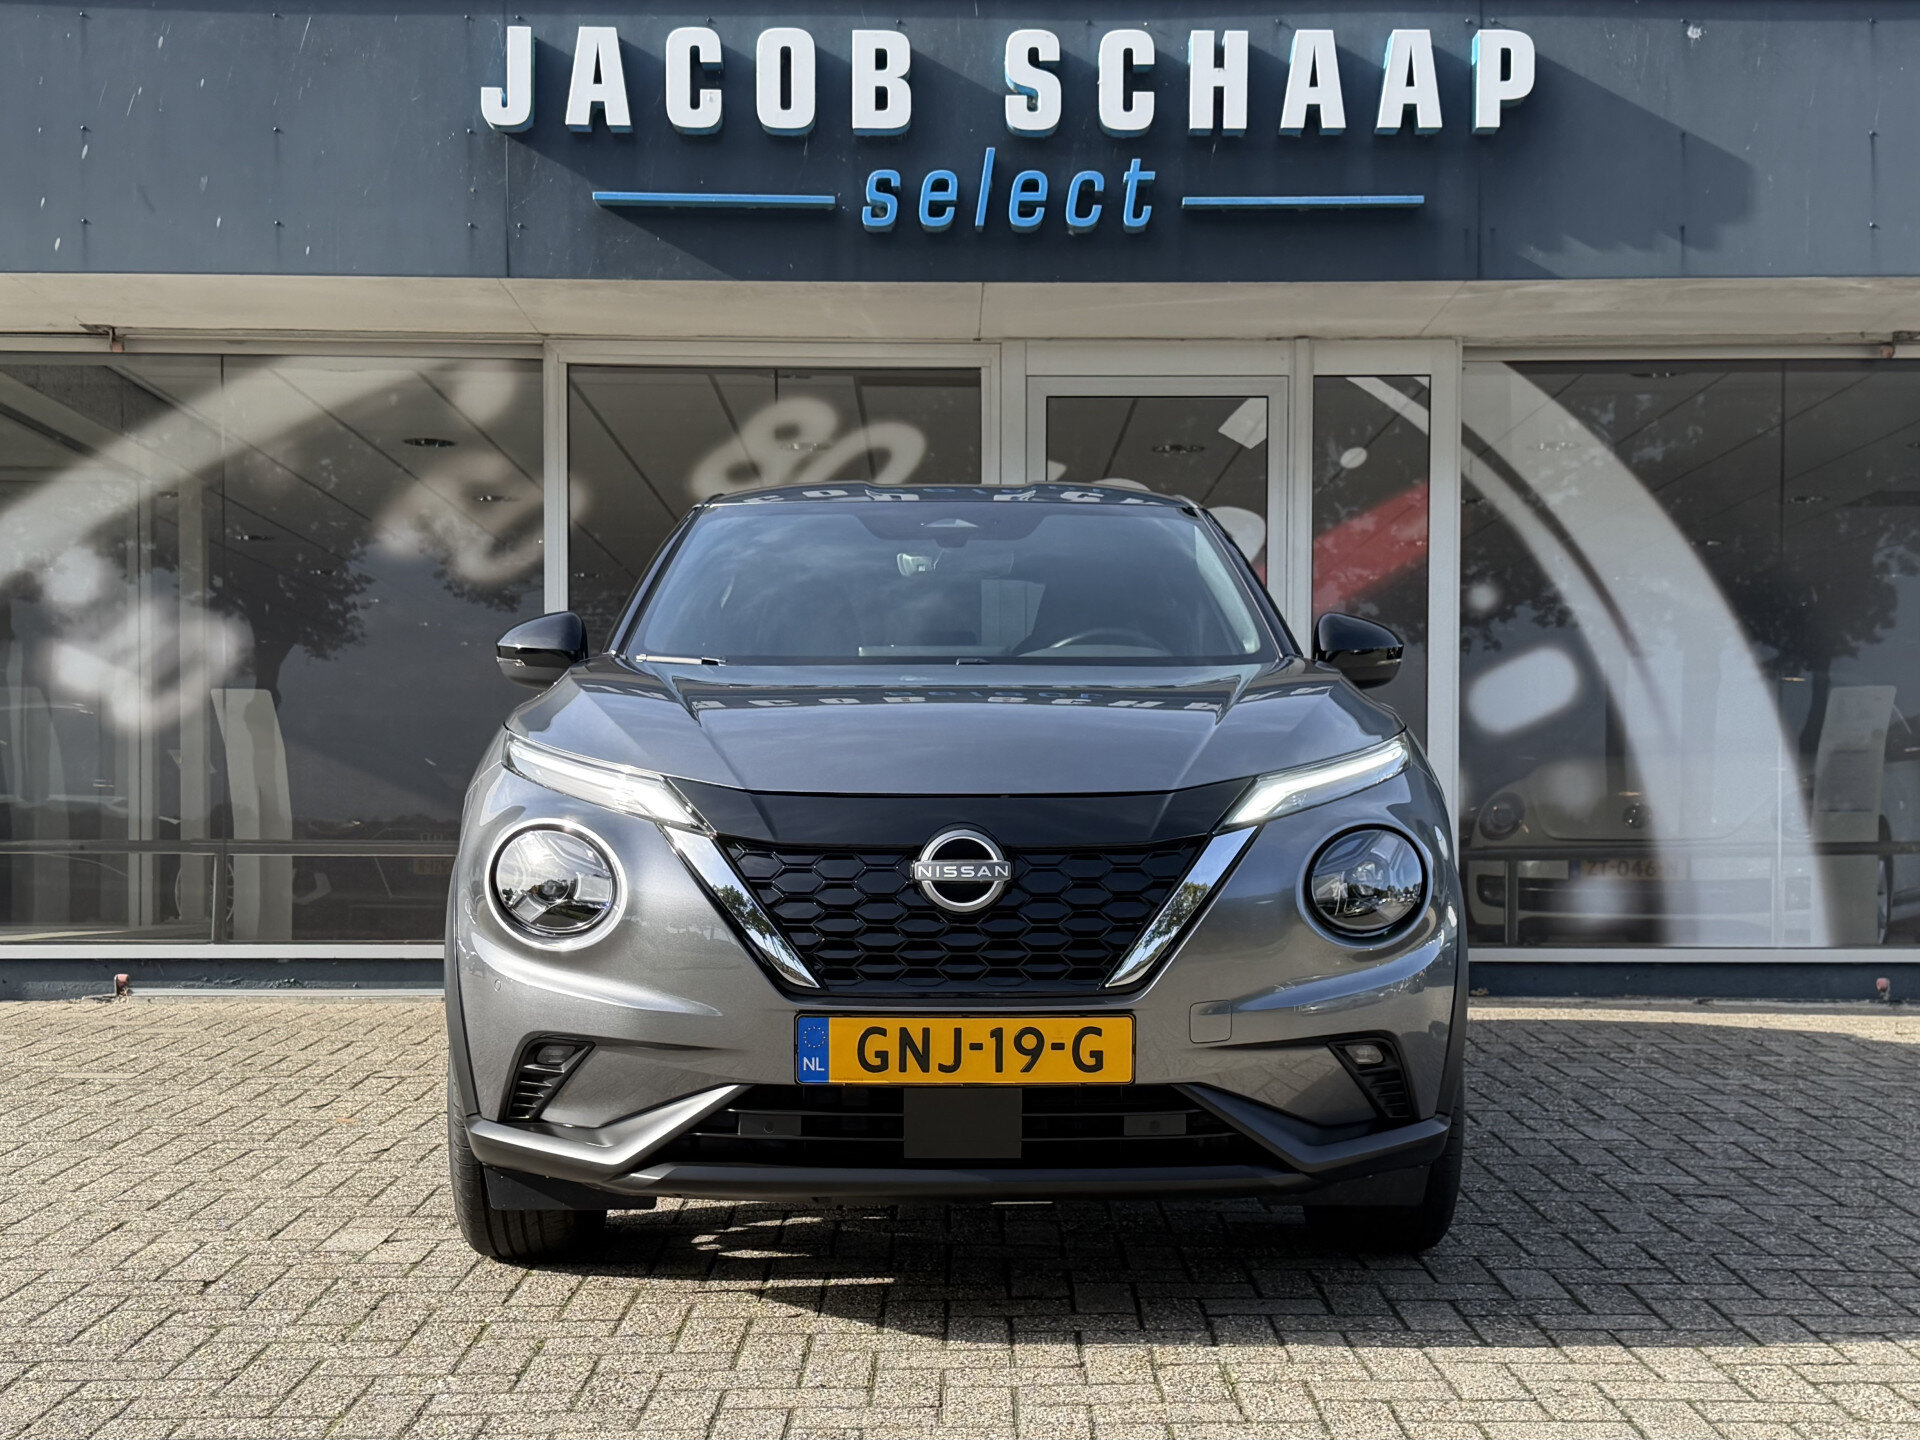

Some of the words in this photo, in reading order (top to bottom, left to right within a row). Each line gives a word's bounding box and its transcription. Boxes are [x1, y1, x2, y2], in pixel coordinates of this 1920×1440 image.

[480, 26, 913, 135] JACOB
[1004, 29, 1536, 136] SCHAAP
[861, 147, 1156, 233] select
[917, 865, 1009, 878] NISSAN
[802, 1057, 826, 1072] NL
[857, 1026, 1105, 1074] GNJ-19-G
